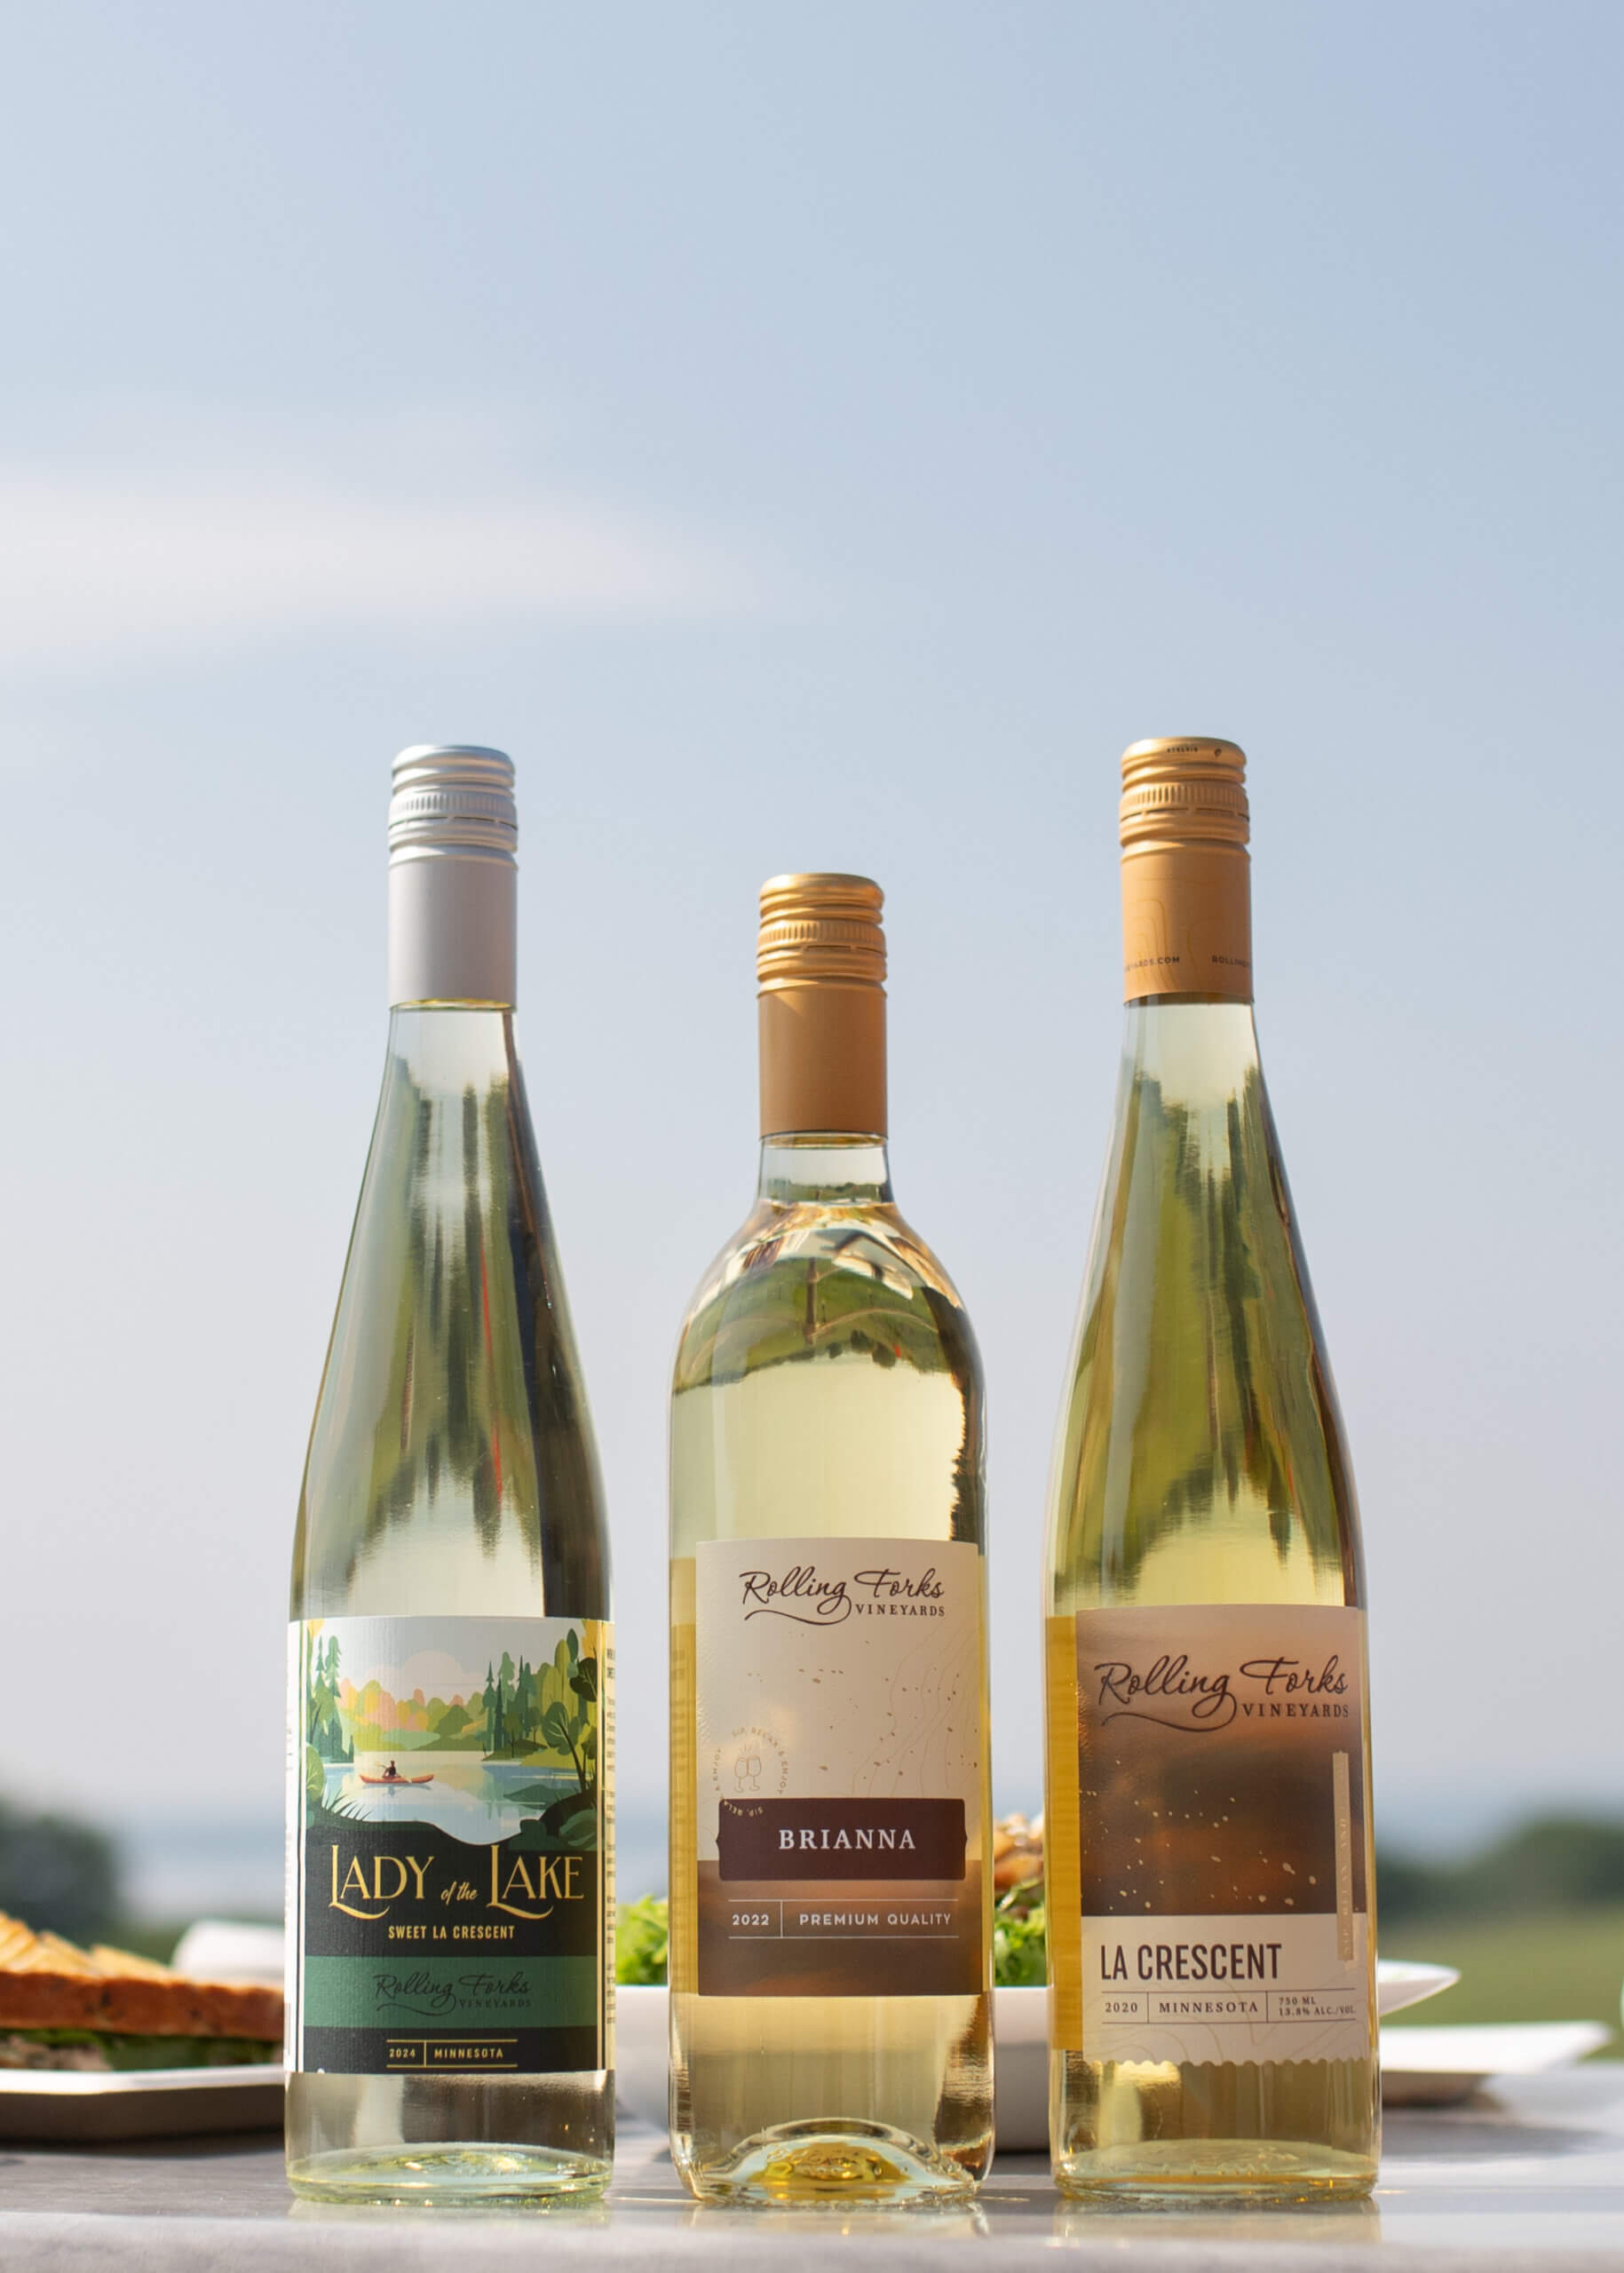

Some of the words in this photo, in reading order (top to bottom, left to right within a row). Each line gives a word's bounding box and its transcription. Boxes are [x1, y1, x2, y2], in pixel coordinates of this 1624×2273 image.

[739, 1565, 852, 1626] Rolling
[853, 1567, 945, 1598] Forks
[855, 1604, 945, 1617] VINEYARDS
[1094, 1654, 1238, 1733] Rolling
[1240, 1654, 1348, 1695] Forks
[1243, 1703, 1349, 1718] VINEYARDS
[778, 1828, 916, 1850] BRIANNA
[328, 1844, 435, 1921] LADY
[440, 1881, 456, 1906] of
[456, 1881, 479, 1901] the
[486, 1844, 585, 1921] LAKE
[732, 1913, 770, 1926] 2022
[799, 1913, 879, 1926] PREMIUM
[887, 1913, 951, 1926] QUALITY
[387, 1925, 427, 1940] SWEET
[432, 1925, 448, 1940] LA
[453, 1925, 515, 1940] CRESCENT
[1101, 1944, 1128, 1980] LA
[1137, 1943, 1282, 1981] CRESCENT
[373, 1971, 456, 2017] Rolling
[458, 1971, 531, 1996] Forks
[1279, 1996, 1298, 2006] 750
[1302, 1995, 1317, 2006] ML
[460, 1999, 532, 2008] VINEYARDS
[1105, 2002, 1138, 2014] 2020
[1159, 2001, 1258, 2014] MINNESOTA
[389, 2047, 416, 2059] 2024
[434, 2047, 503, 2059] MINNESOTA
